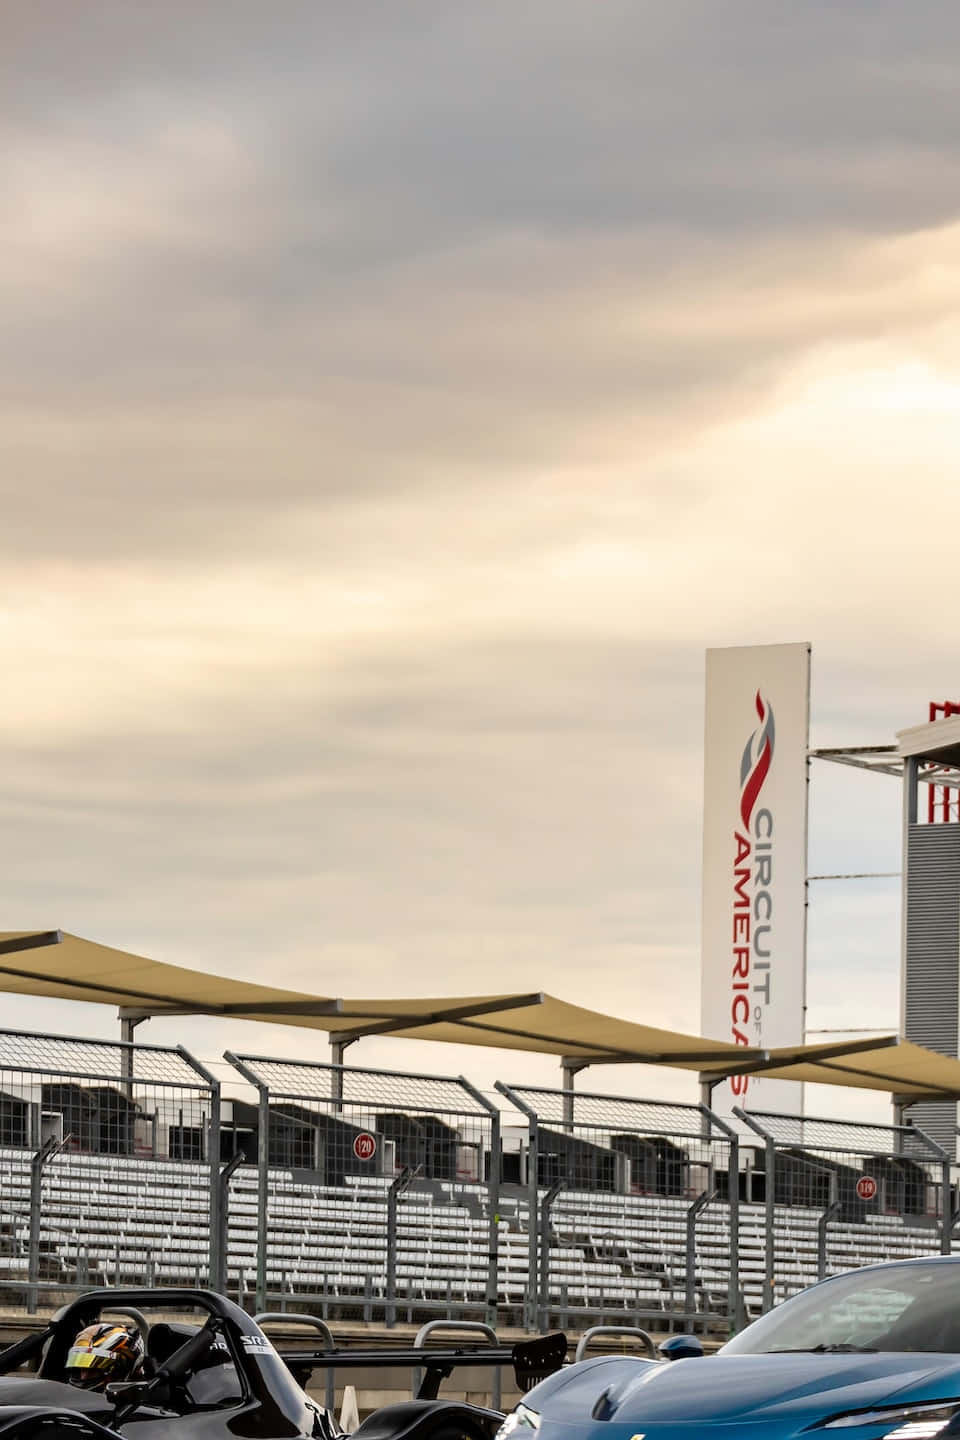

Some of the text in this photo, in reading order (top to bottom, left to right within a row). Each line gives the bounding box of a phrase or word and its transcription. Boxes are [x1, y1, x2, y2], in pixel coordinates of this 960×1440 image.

[754, 808, 773, 1005] CIRCUIT
[731, 832, 751, 1095] AMERICAS
[753, 1006, 762, 1036] OF
[358, 1140, 372, 1153] 120
